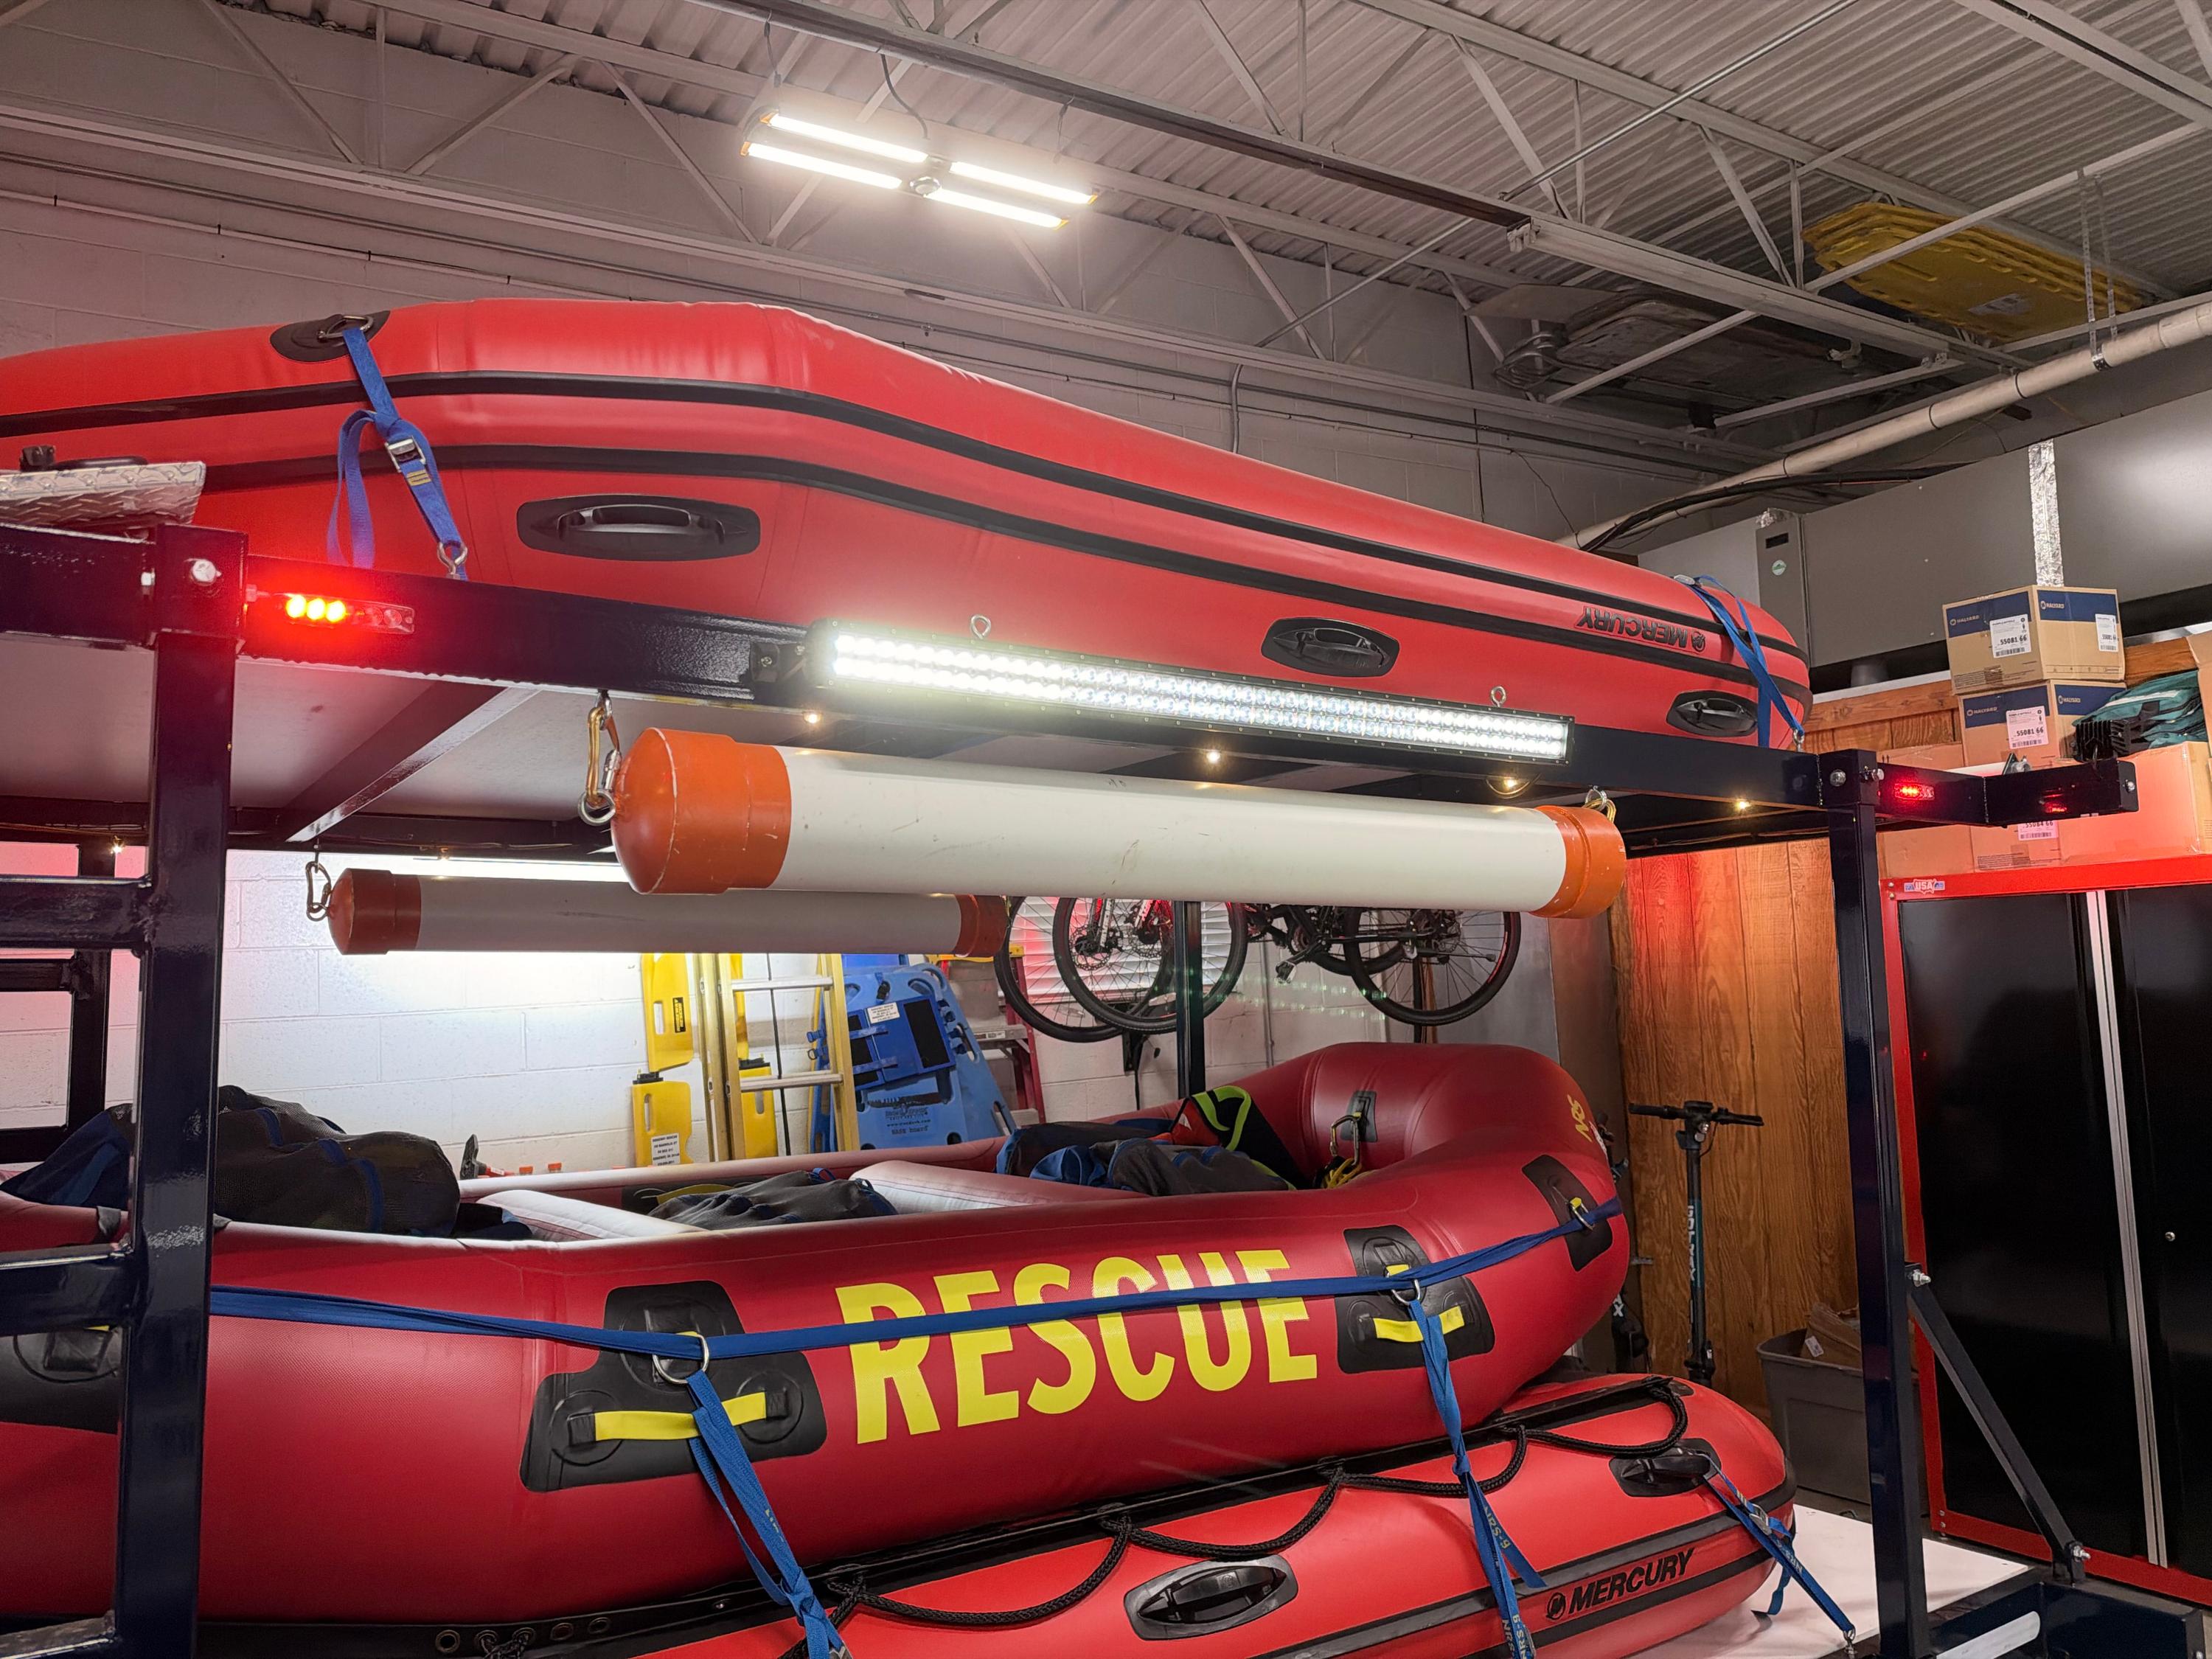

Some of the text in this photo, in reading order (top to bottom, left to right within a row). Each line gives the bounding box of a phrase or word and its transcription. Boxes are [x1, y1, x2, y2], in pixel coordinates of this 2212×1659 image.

[1577, 607, 1688, 648] MERCURY
[1973, 706, 1997, 714] HALYARD
[2017, 728, 2034, 737] 55081
[1915, 881, 1933, 891] USA
[835, 1249, 1318, 1444] RESCUE
[1568, 1548, 1694, 1614] MERCURY
